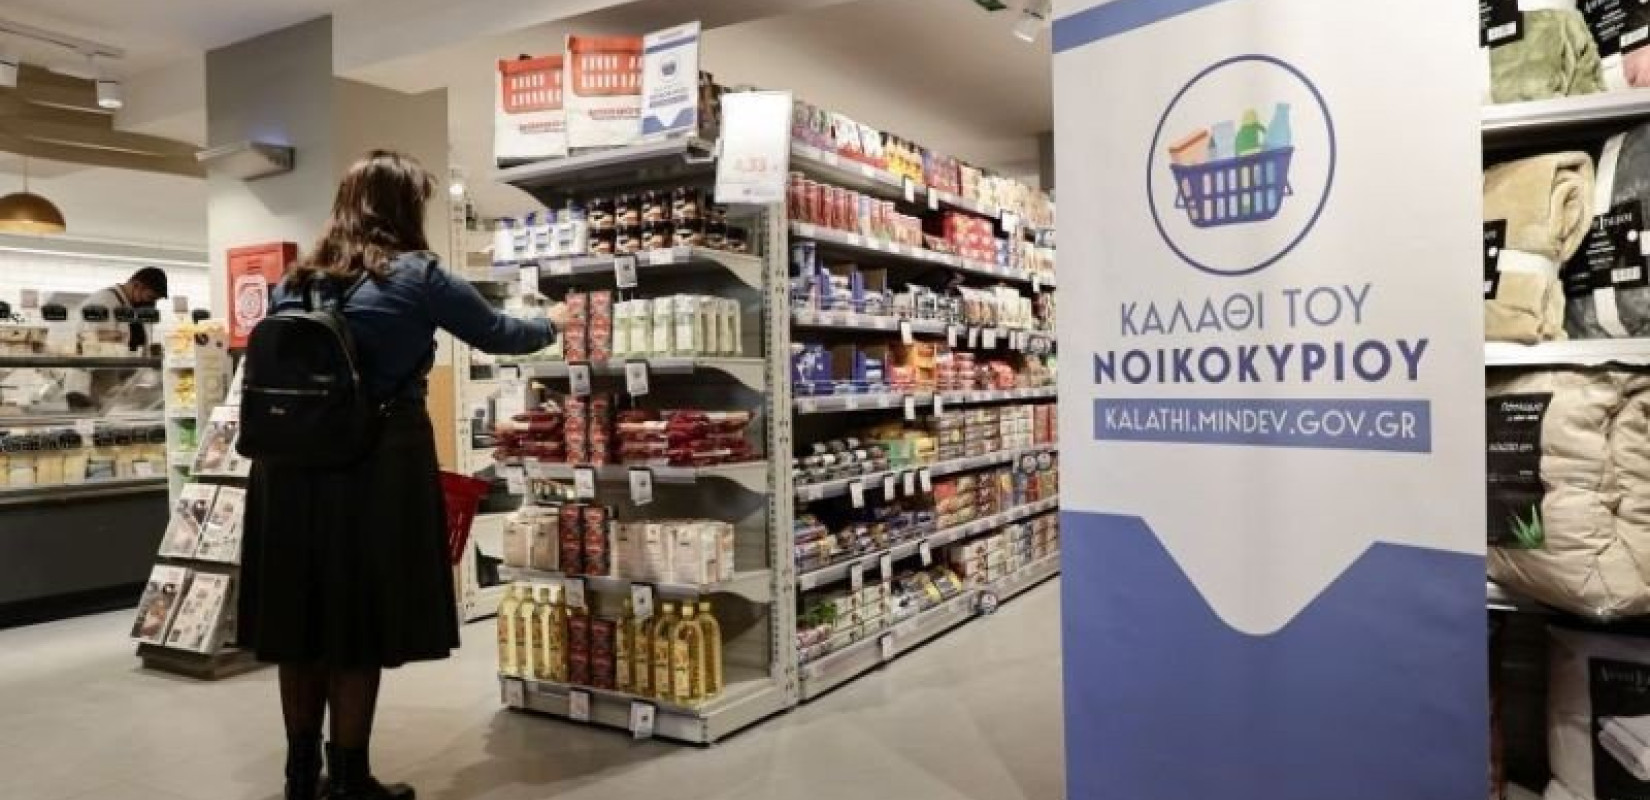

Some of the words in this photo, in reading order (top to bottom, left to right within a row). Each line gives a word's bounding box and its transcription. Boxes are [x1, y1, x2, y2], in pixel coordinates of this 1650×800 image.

[1120, 291, 1264, 337] ΚΑΛΑΘΙ
[1282, 283, 1371, 328] ΤΟΥ
[1094, 338, 1429, 384] ΝΟΙΚΟΚΥΡΙΟΥ
[1104, 407, 1417, 440] KALATHI.MINDEV.GOV.GR
